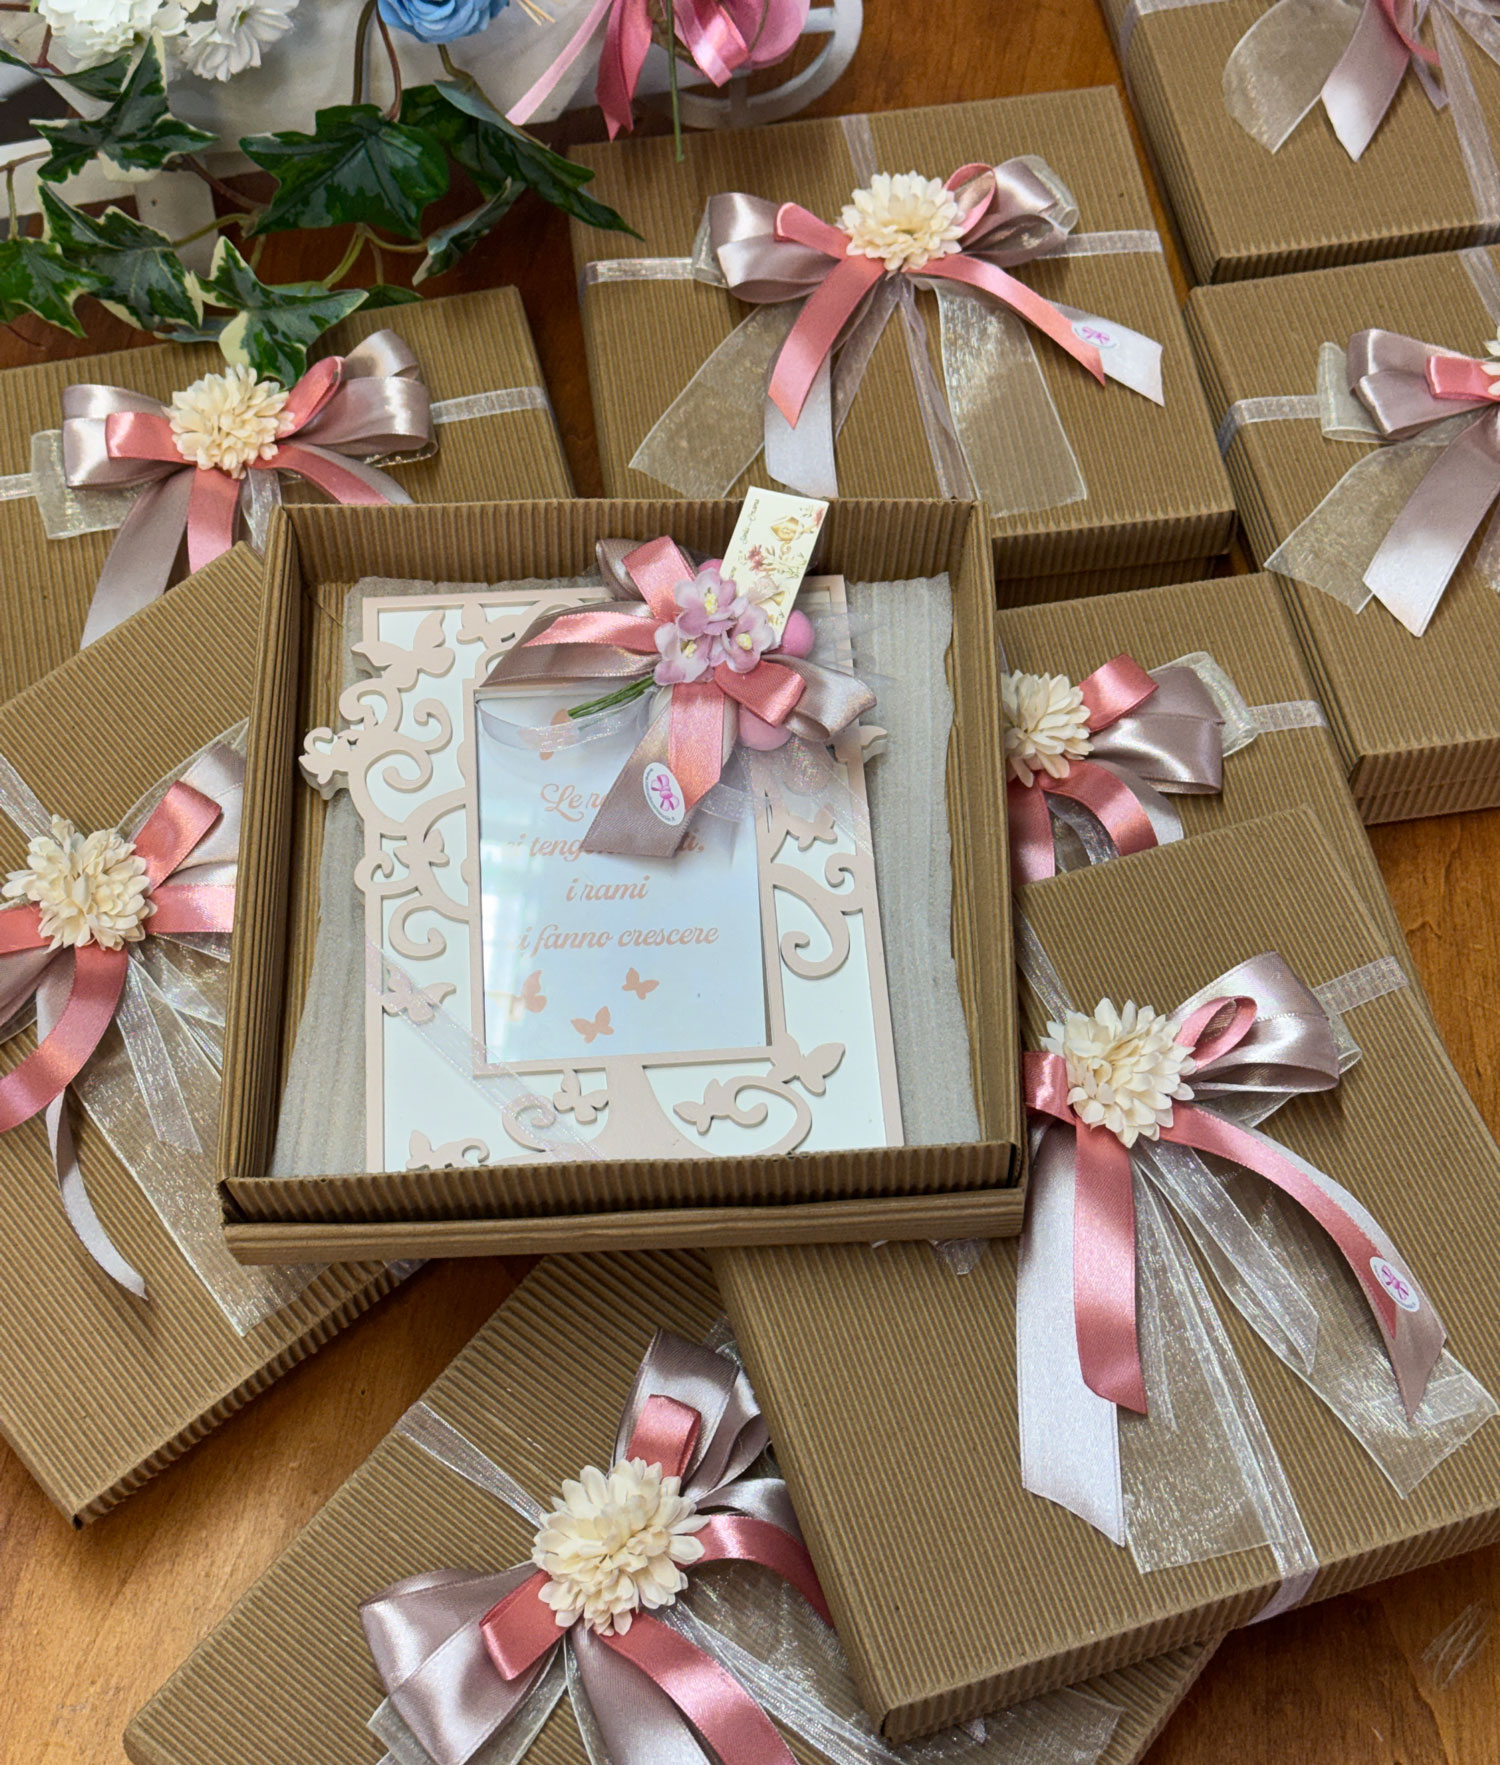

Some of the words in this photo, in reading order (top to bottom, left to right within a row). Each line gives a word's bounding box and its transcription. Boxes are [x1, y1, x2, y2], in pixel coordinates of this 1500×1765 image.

[540, 783, 584, 822] Le
[529, 837, 605, 862] teng
[580, 874, 650, 901] rami
[530, 923, 613, 958] fanno
[617, 926, 719, 948] crescere
